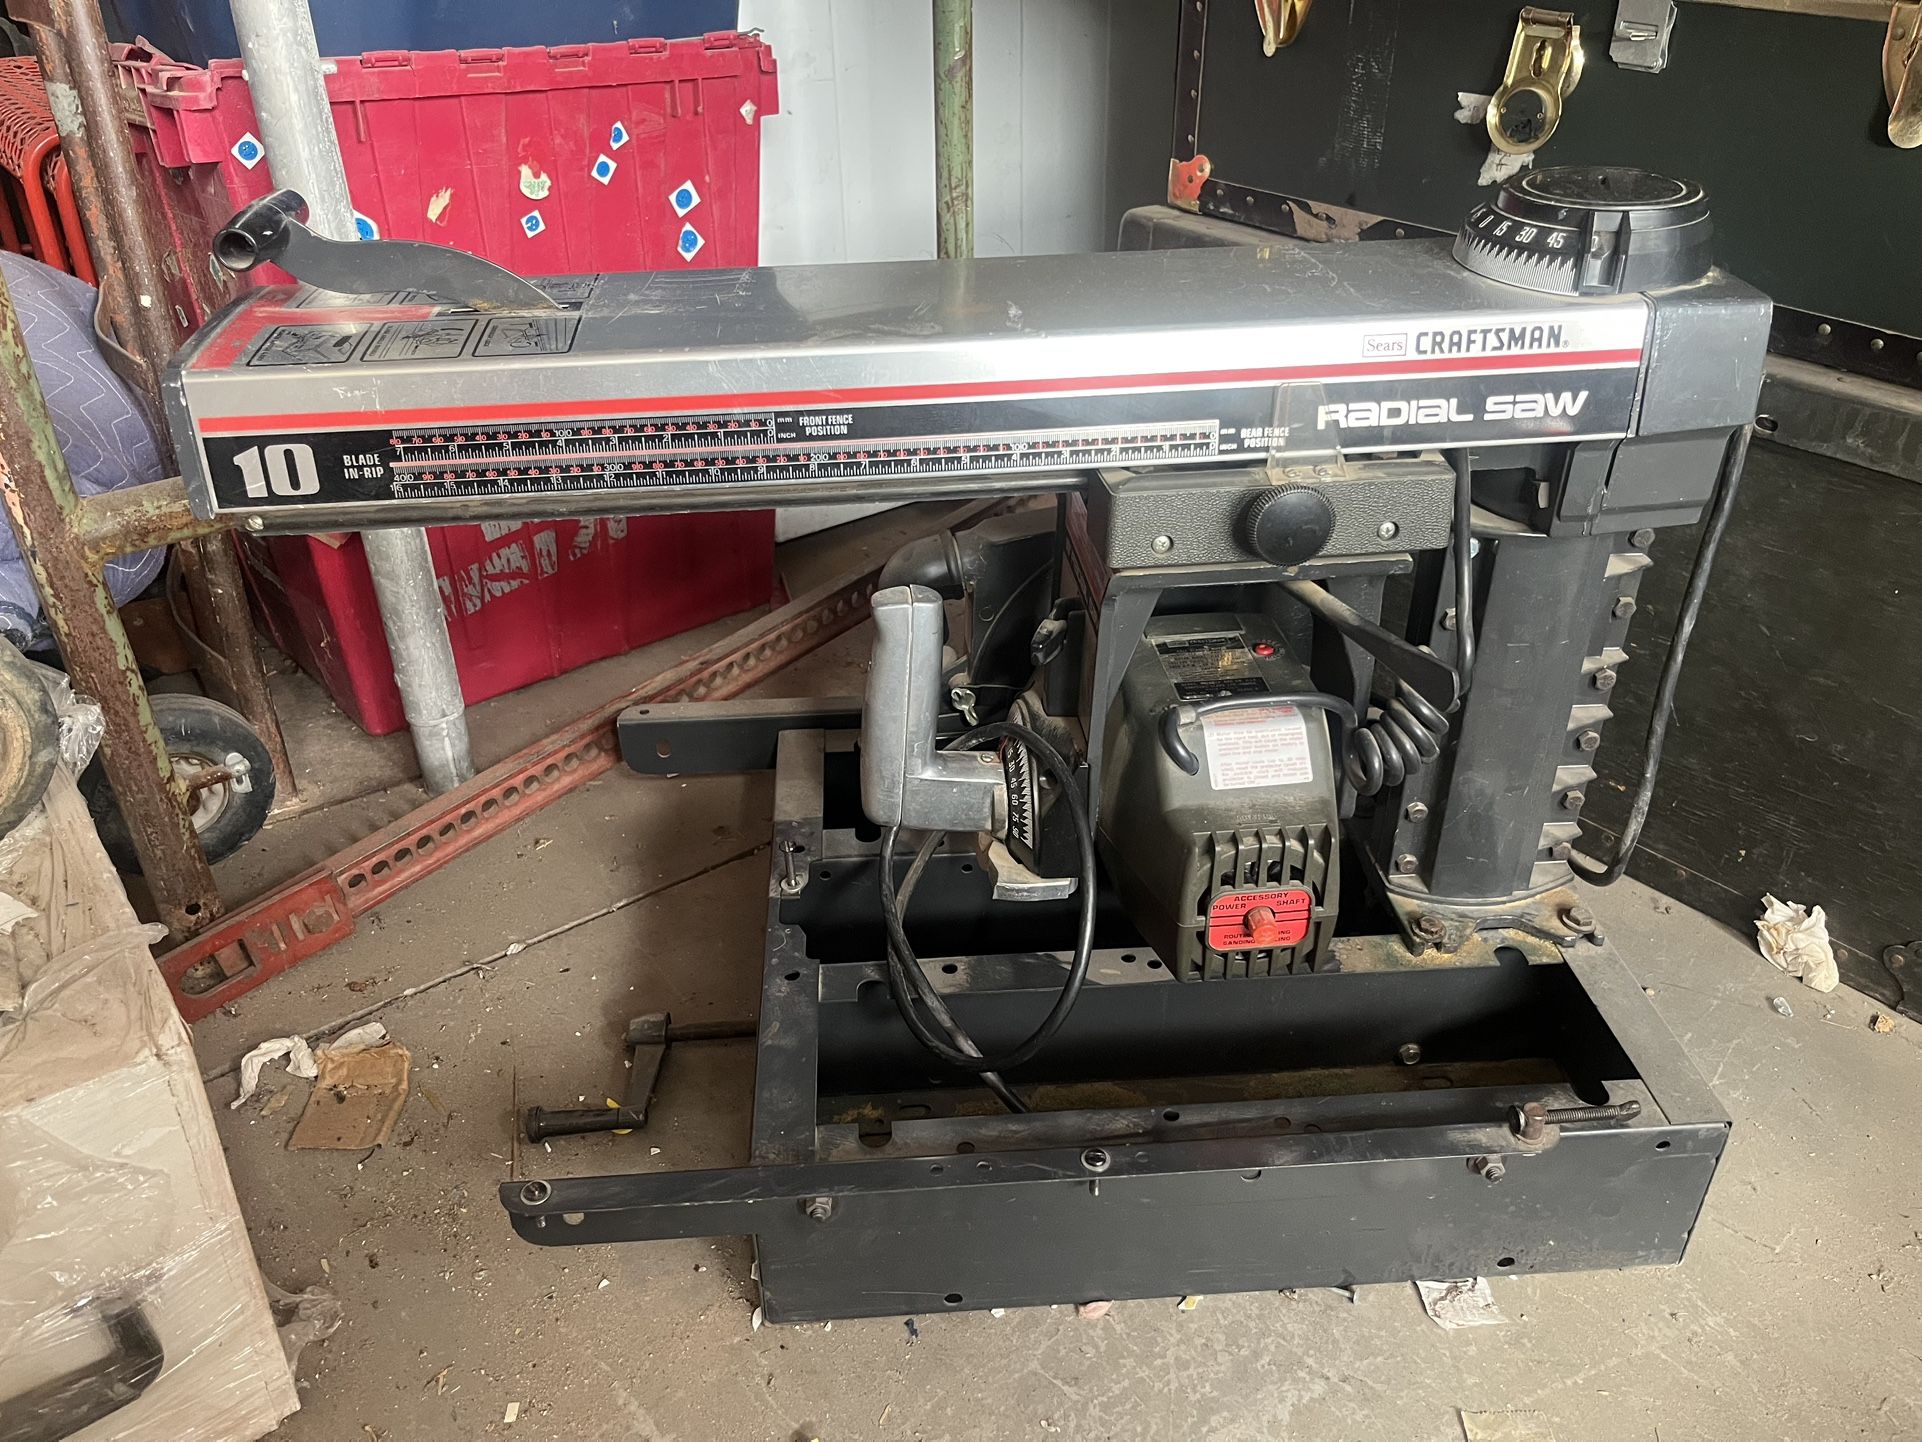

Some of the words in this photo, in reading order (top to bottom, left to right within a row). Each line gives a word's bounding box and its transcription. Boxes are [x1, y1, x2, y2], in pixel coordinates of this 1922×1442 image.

[1479, 215, 1494, 228] 0
[1493, 220, 1512, 236] 15
[1515, 226, 1538, 243] 30
[1546, 232, 1566, 248] 45
[1367, 336, 1403, 351] Sears
[800, 416, 827, 426] FRONT
[828, 414, 853, 424] FENCE
[806, 426, 848, 436] POSITION
[1240, 428, 1263, 438] REAR
[1264, 427, 1290, 437] FENCE
[1244, 437, 1285, 448] POSITION
[343, 454, 381, 466] BLADE
[233, 444, 320, 498] 10
[344, 466, 384, 480] IN-RIP
[1008, 760, 1016, 772] 30
[1010, 778, 1018, 788] 45
[1012, 794, 1018, 806] 60
[1012, 812, 1019, 823] 75
[1012, 826, 1020, 839] 90
[1234, 892, 1289, 902] ACCESSORY
[1276, 898, 1306, 906] SHAFT
